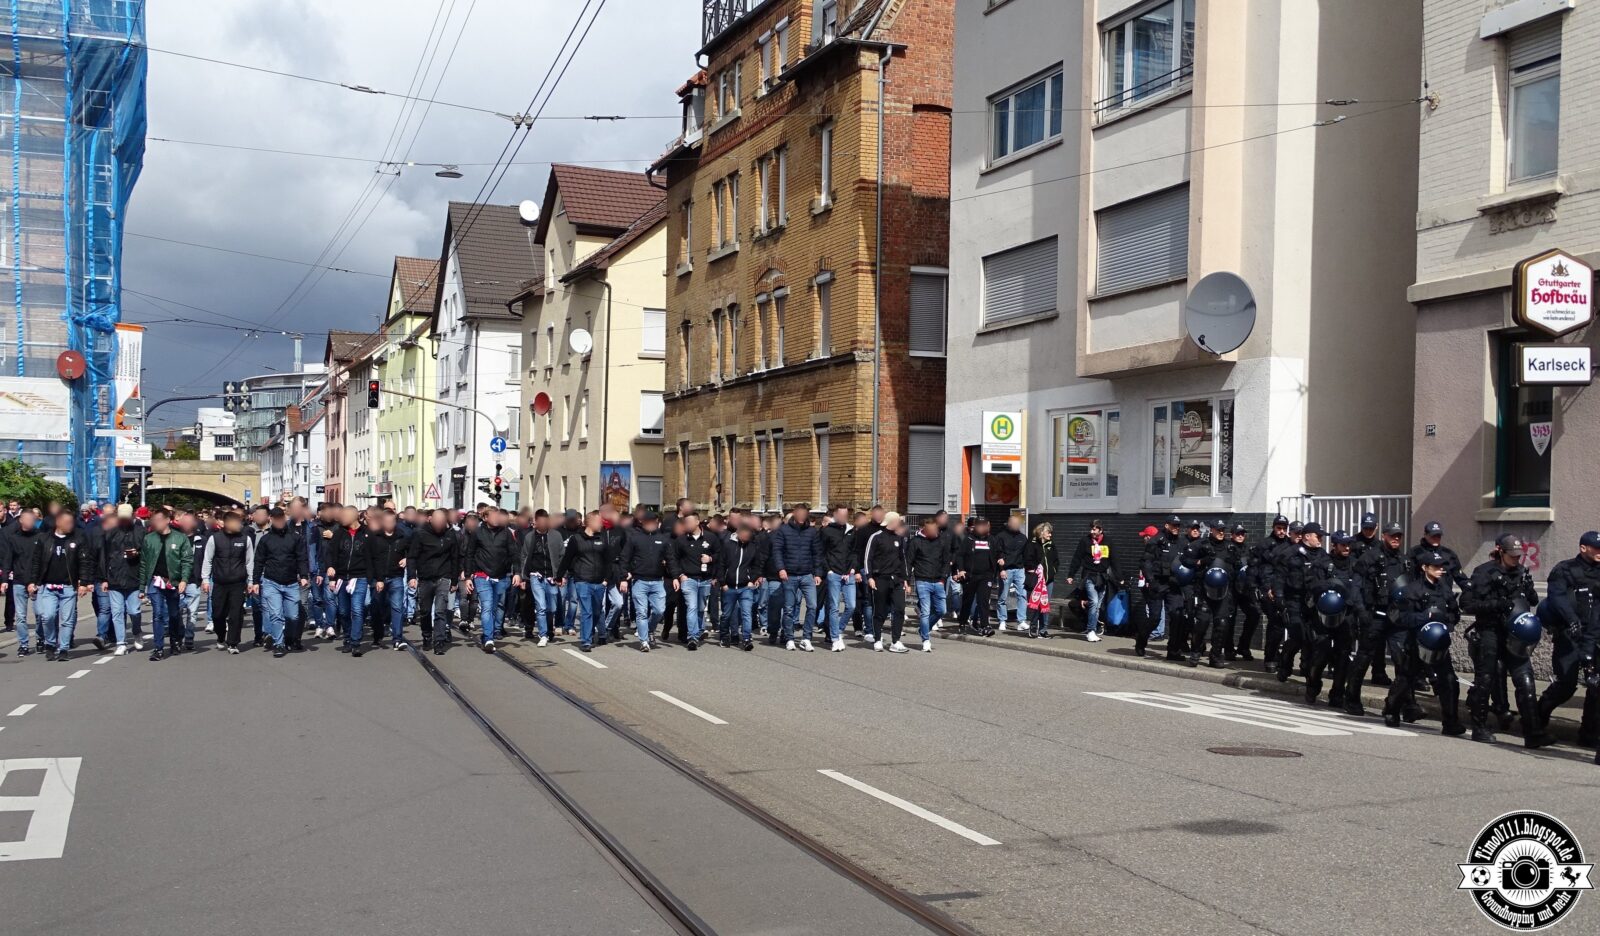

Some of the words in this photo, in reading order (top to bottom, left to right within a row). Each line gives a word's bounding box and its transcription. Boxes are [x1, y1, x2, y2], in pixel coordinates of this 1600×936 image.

[1538, 278, 1581, 289] Stuttgarter
[1531, 288, 1587, 305] Hofbräu
[1528, 358, 1586, 371] Karlseck
[997, 420, 1008, 434] H
